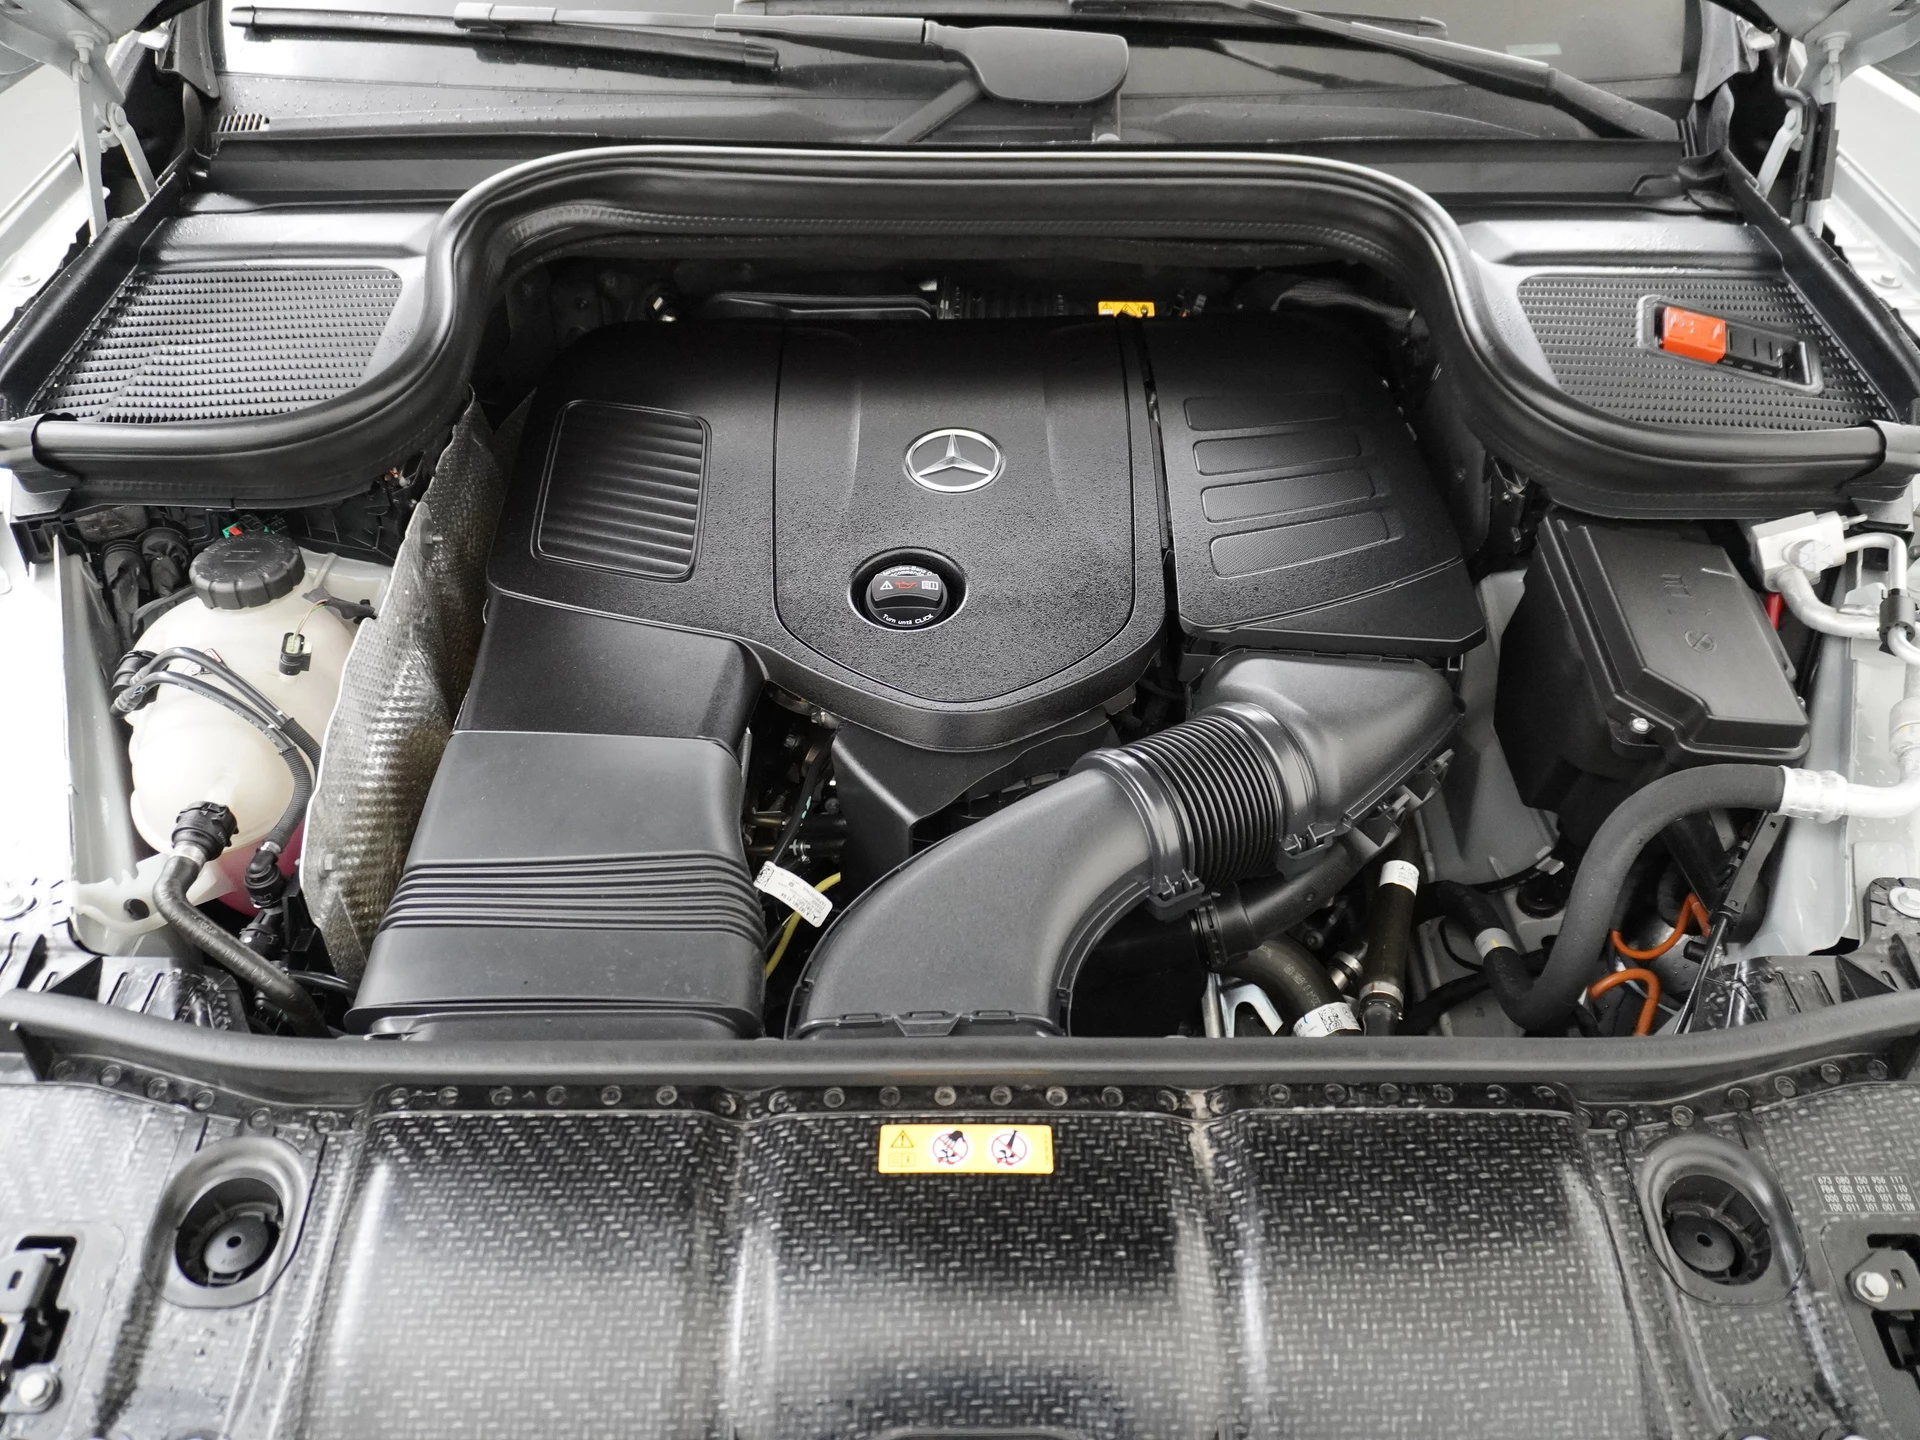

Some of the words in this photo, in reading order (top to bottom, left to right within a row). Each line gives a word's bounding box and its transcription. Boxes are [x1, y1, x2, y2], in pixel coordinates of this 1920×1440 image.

[882, 613, 896, 623] Turn
[915, 613, 934, 624] CLICK
[1818, 1176, 1832, 1184] 673
[1854, 1176, 1868, 1184] 150
[1871, 1176, 1886, 1184] 956
[1890, 1175, 1903, 1183] 111
[1856, 1185, 1871, 1193] 011
[1874, 1185, 1889, 1193] 001
[1893, 1184, 1907, 1192] 110
[1824, 1194, 1839, 1202] 000
[1842, 1194, 1857, 1202] 001
[1861, 1194, 1875, 1202] 100
[1879, 1194, 1893, 1202] 101
[1896, 1193, 1911, 1201] 000
[1829, 1203, 1843, 1212] 100
[1846, 1203, 1860, 1212] 011
[1865, 1203, 1878, 1212] 101
[1882, 1202, 1896, 1211] 001
